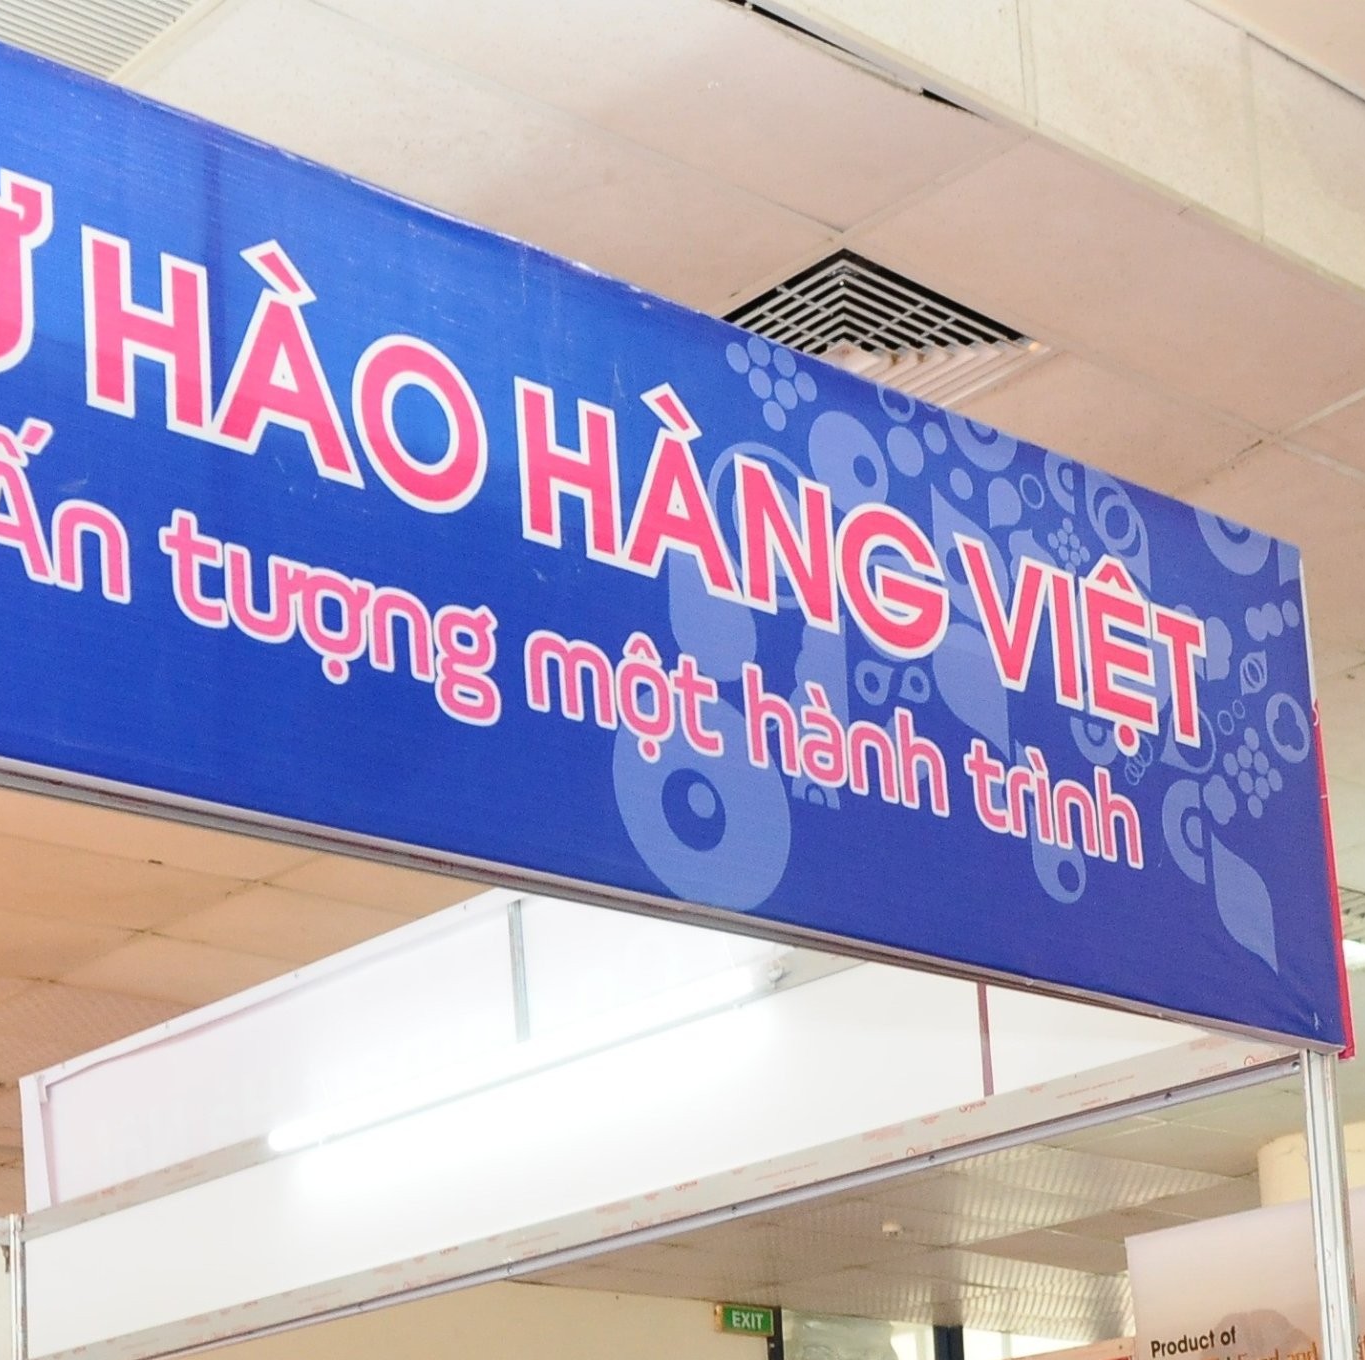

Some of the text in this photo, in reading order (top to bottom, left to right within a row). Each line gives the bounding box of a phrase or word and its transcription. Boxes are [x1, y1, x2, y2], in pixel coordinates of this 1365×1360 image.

[79, 238, 489, 514] HÀO
[514, 381, 951, 661] HÀNG
[960, 532, 1209, 757] VIỆT
[160, 510, 499, 728] tượng
[525, 628, 719, 766] một
[745, 660, 949, 820] hành
[964, 735, 1145, 871] trình
[731, 1309, 764, 1330] EXIT
[1150, 1325, 1237, 1358] Product of
